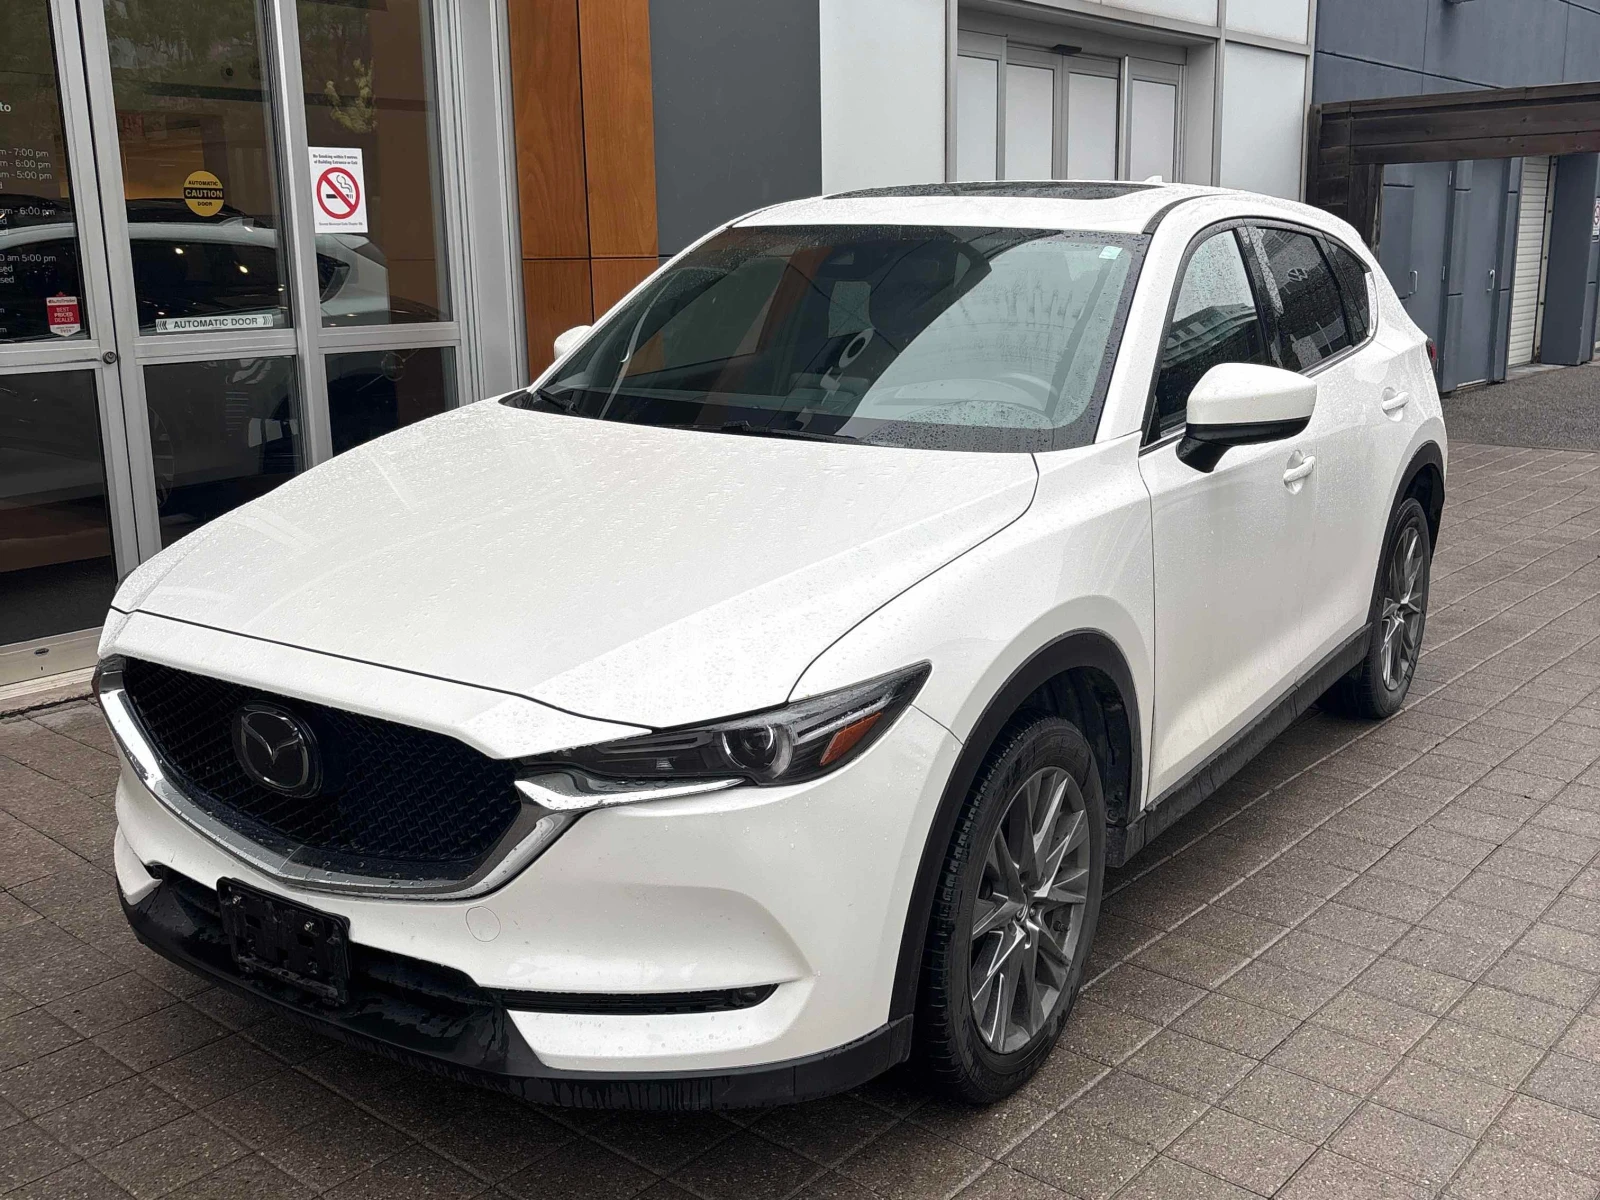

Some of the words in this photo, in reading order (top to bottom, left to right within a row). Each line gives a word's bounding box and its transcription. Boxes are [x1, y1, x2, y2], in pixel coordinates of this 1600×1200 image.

[13, 148, 34, 157] 7:00
[35, 150, 49, 158] pm
[15, 159, 36, 168] 6:00
[37, 161, 51, 170] pm
[16, 170, 37, 179] 5:00
[38, 172, 53, 181] pm
[185, 189, 223, 198] CAUTION
[20, 206, 40, 216] 6:00
[41, 207, 56, 217] pm
[21, 254, 42, 262] 5:00
[43, 254, 57, 263] pm
[173, 318, 229, 329] AUTOMATIC
[231, 317, 258, 326] DOOR
